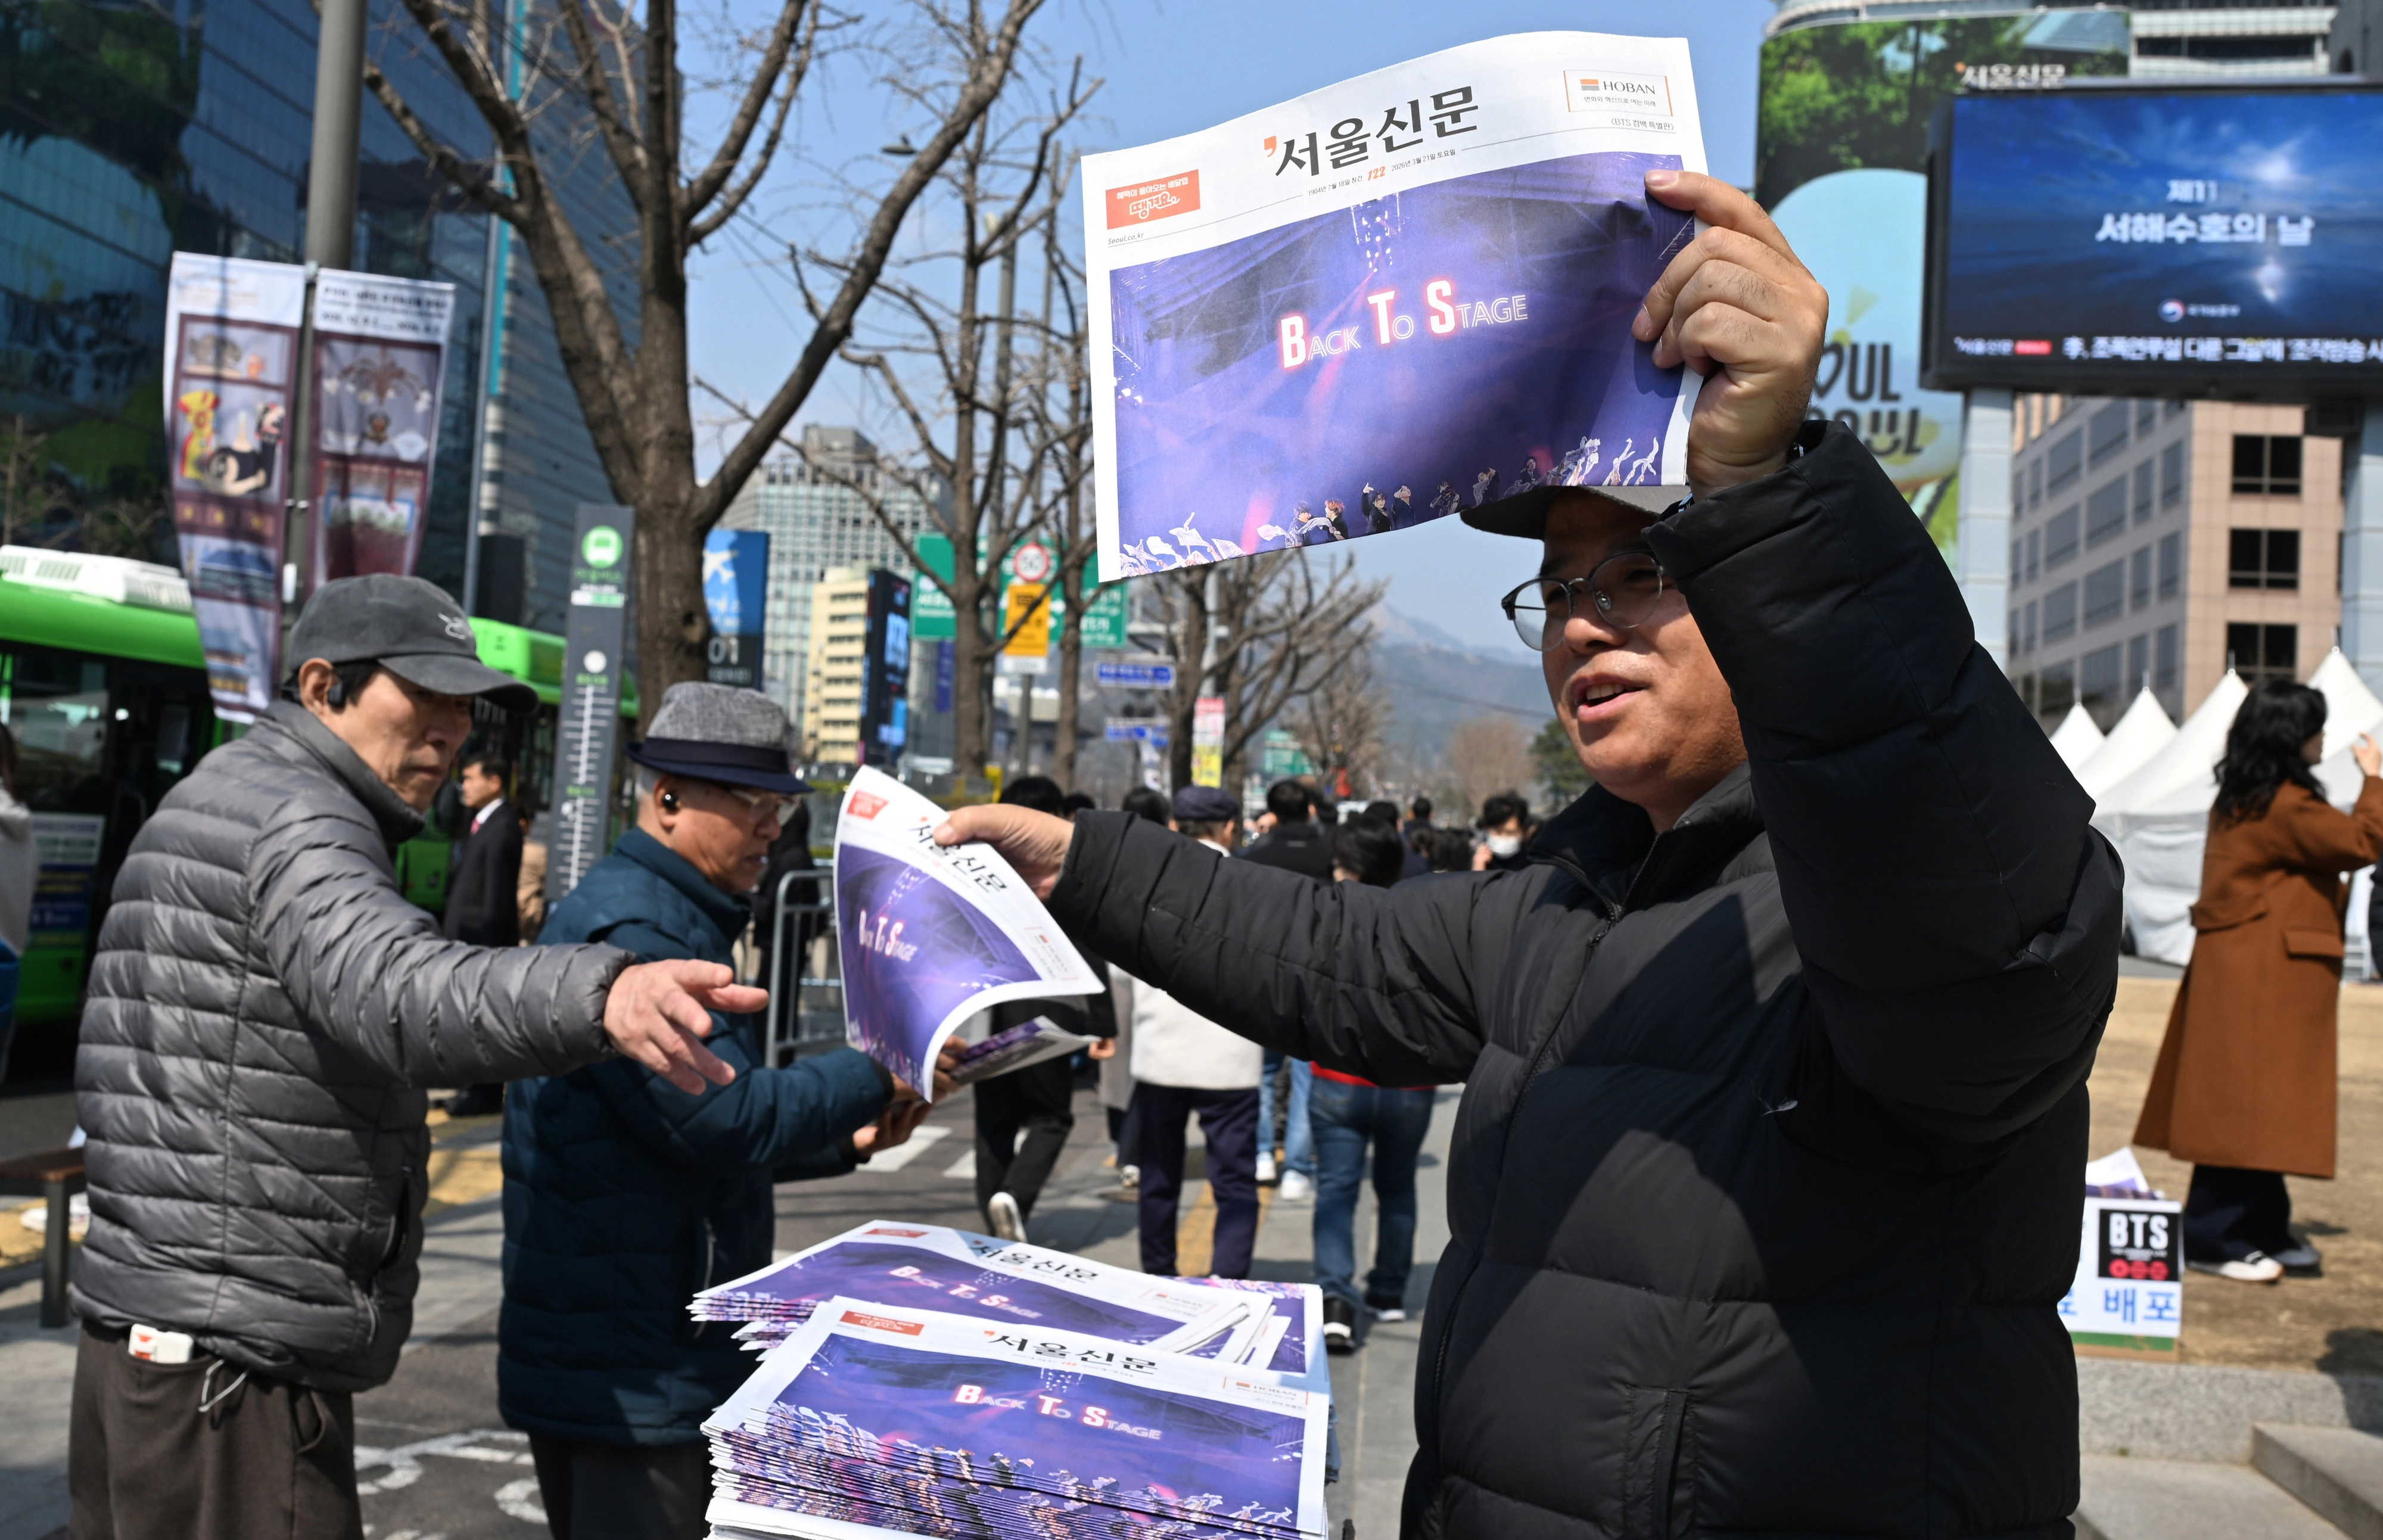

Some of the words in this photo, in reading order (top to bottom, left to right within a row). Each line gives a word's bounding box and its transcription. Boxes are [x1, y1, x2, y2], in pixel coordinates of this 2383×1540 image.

[1603, 80, 1656, 95] HOBAN
[1633, 119, 1647, 129] 컴백
[1308, 185, 1327, 196] 1904년
[1338, 179, 1351, 188] 18일
[1367, 166, 1386, 182] 122
[1391, 160, 1411, 172] 2026년
[1412, 157, 1422, 166] 3월
[1423, 154, 1436, 163] 21일
[1437, 148, 1456, 159] 토요일
[1116, 189, 1137, 200] 혜택이
[1139, 183, 1166, 195] 돌아오는
[1168, 176, 1189, 188] 배달앱
[1130, 191, 1180, 219] 땡겨요
[1108, 232, 1144, 245] Seoul.co.kr
[2095, 213, 2266, 244] 서해수호의
[2277, 215, 2315, 245] 날
[2108, 1212, 2169, 1250] BTS
[2103, 1287, 2178, 1324] 배포
